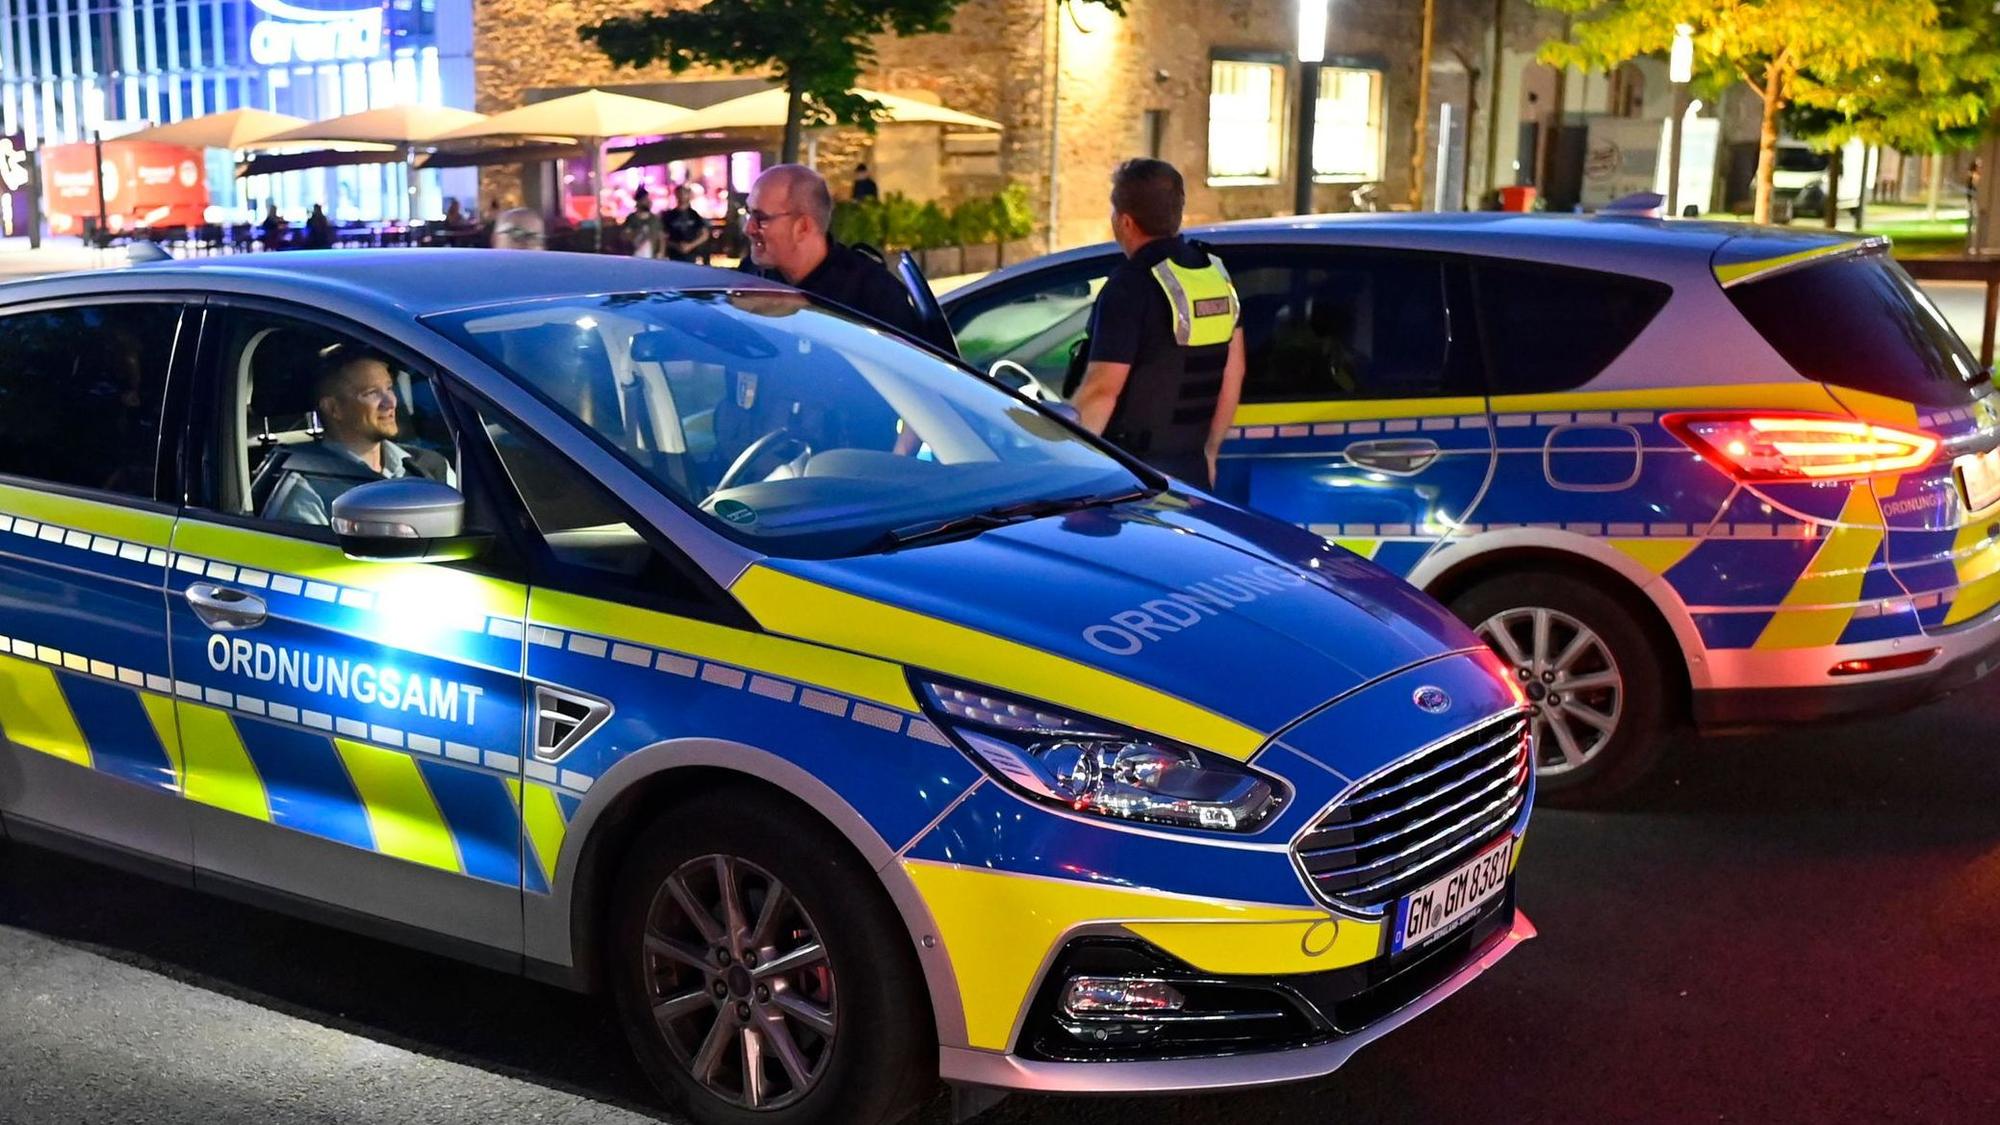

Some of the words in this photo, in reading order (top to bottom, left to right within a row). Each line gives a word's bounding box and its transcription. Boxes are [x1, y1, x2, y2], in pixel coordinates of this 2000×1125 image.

[1882, 494, 1944, 516] ORDNUNG
[1082, 566, 1308, 656] ORDNUNG
[207, 633, 484, 726] ORDNUNGSAMT
[1407, 890, 1435, 938] GM
[1444, 869, 1470, 918] GM
[1469, 845, 1508, 902] 8381
